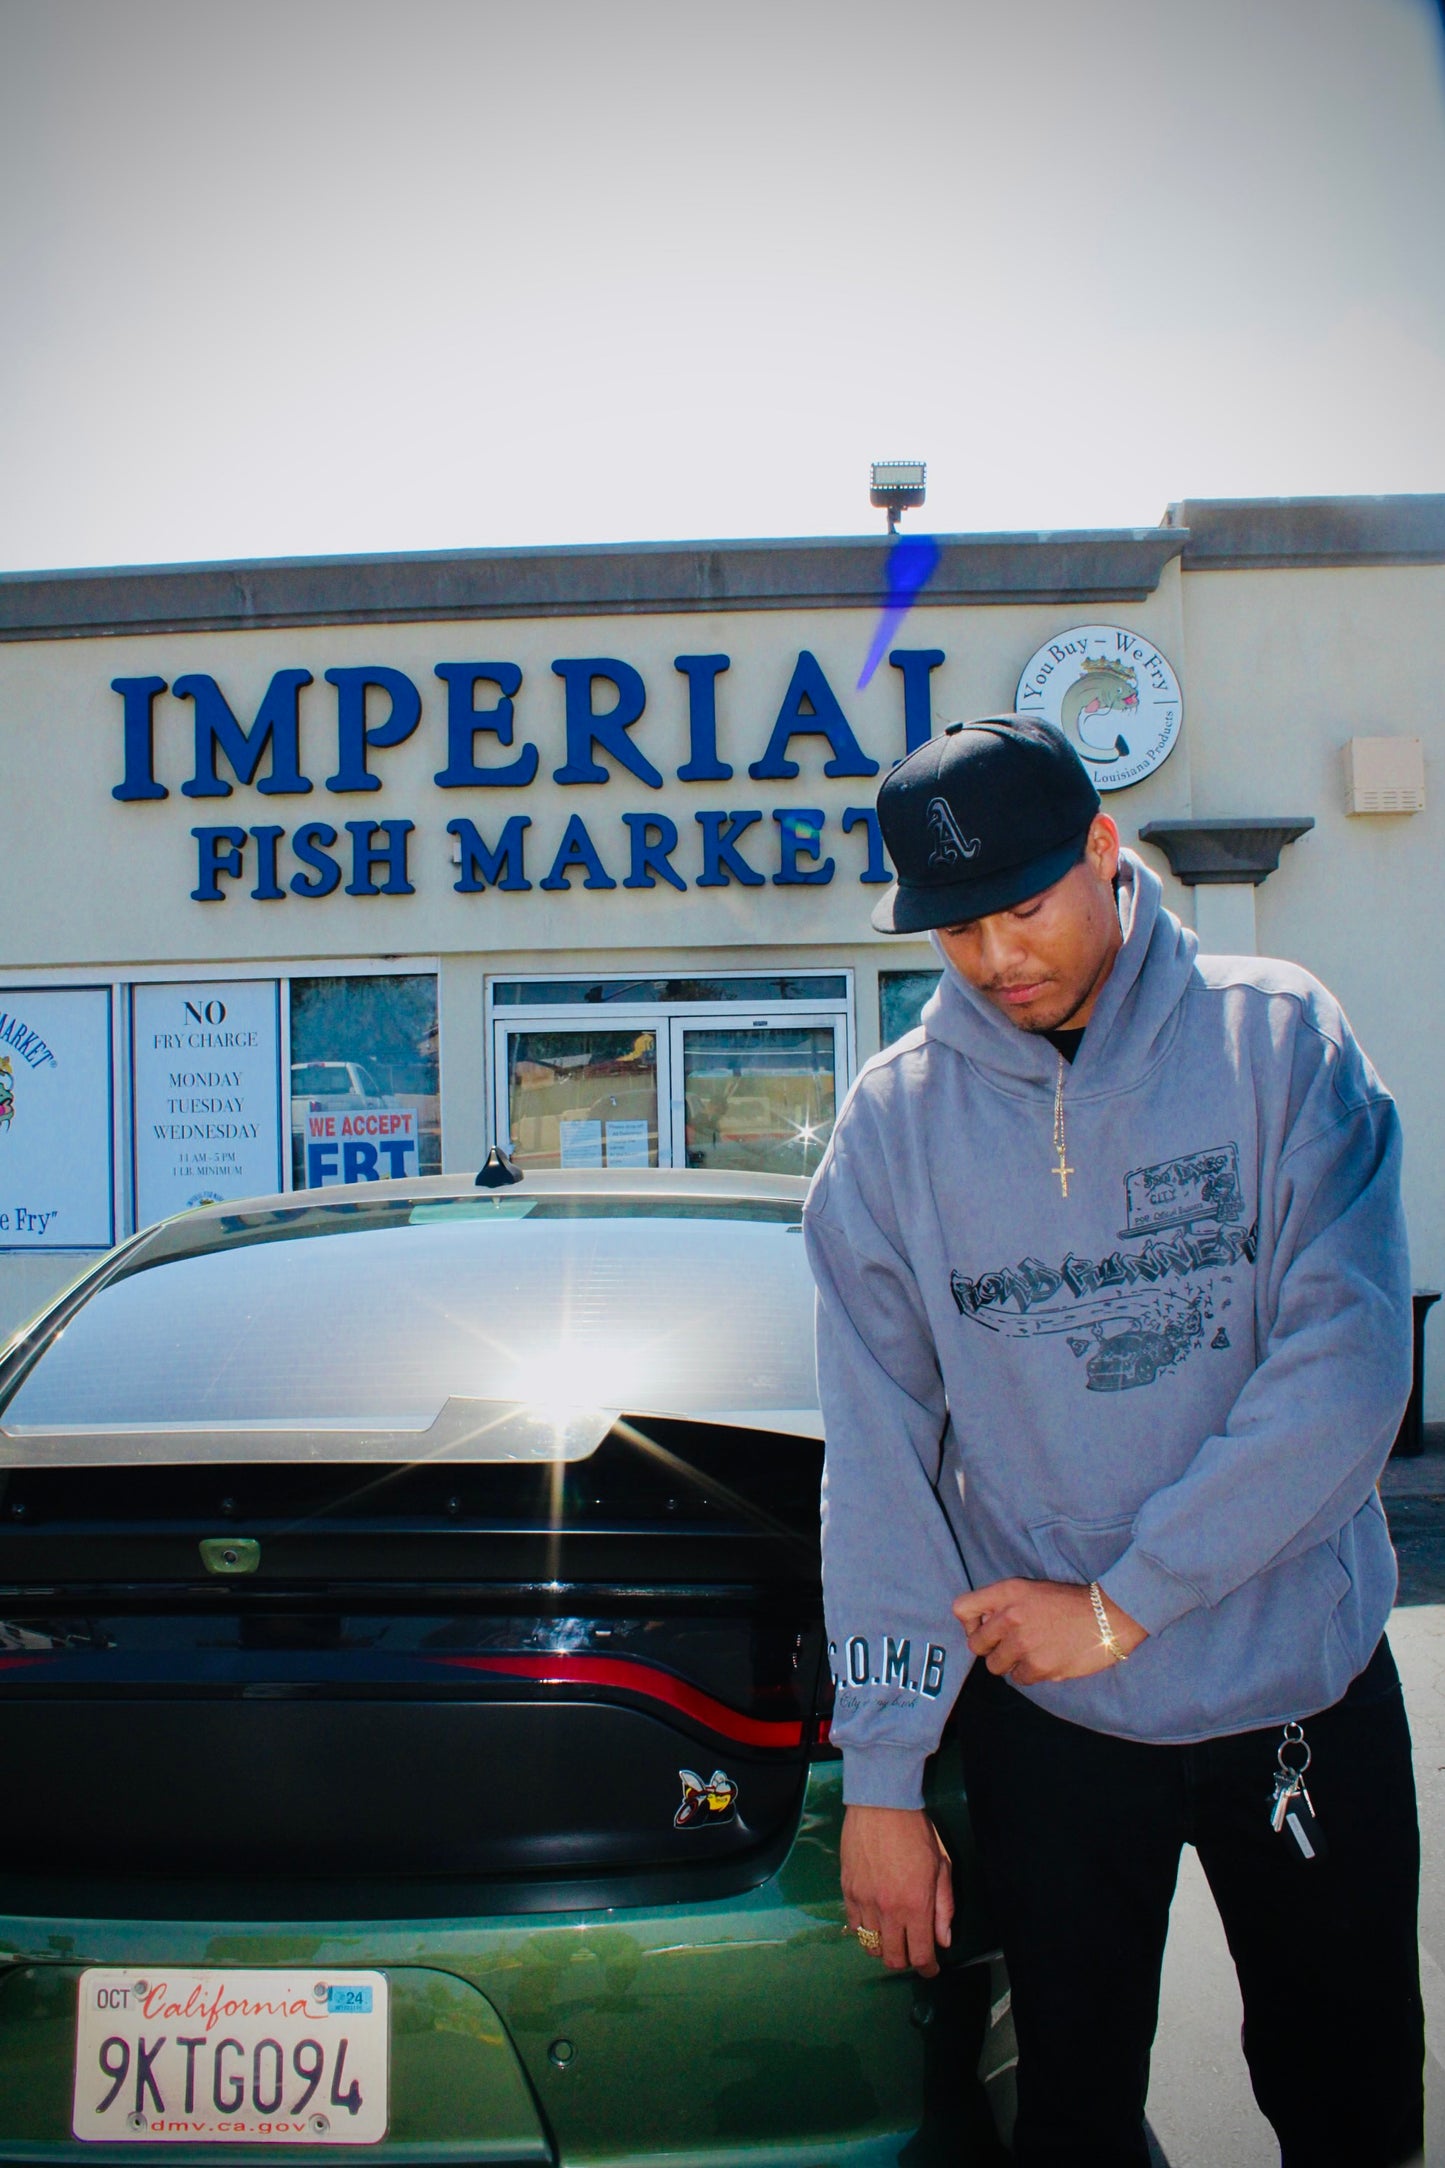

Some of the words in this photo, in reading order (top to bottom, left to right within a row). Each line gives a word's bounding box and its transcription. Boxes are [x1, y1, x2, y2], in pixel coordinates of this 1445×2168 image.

[1023, 661, 1054, 699] You
[1048, 638, 1088, 664] Buy
[1115, 632, 1143, 661] We
[1143, 655, 1169, 692] Fry
[1093, 759, 1150, 783] Louisiana
[1147, 710, 1174, 761] Products
[190, 819, 416, 901] FISH
[447, 806, 894, 893] MARKET
[182, 1000, 227, 1026] NO
[153, 1033, 185, 1050] FRY
[188, 1031, 259, 1049] CHARGE
[169, 1071, 243, 1088] MONDAY
[167, 1097, 245, 1114] TUESDAY
[153, 1123, 260, 1140] WEDNESDAY
[308, 1117, 336, 1137] WE
[341, 1113, 413, 1136] ACCEPT
[179, 1153, 189, 1163] 11
[191, 1152, 207, 1163] AM
[222, 1151, 236, 1162] PM
[197, 1165, 243, 1176] MINIMUM
[951, 1256, 1062, 1315] ROAD
[97, 1988, 131, 2009] OCT
[142, 1983, 329, 2032] California
[345, 1991, 363, 2005] 24
[95, 2036, 363, 2115] 9KTG094
[151, 2120, 306, 2135] dmv.ca.gov
